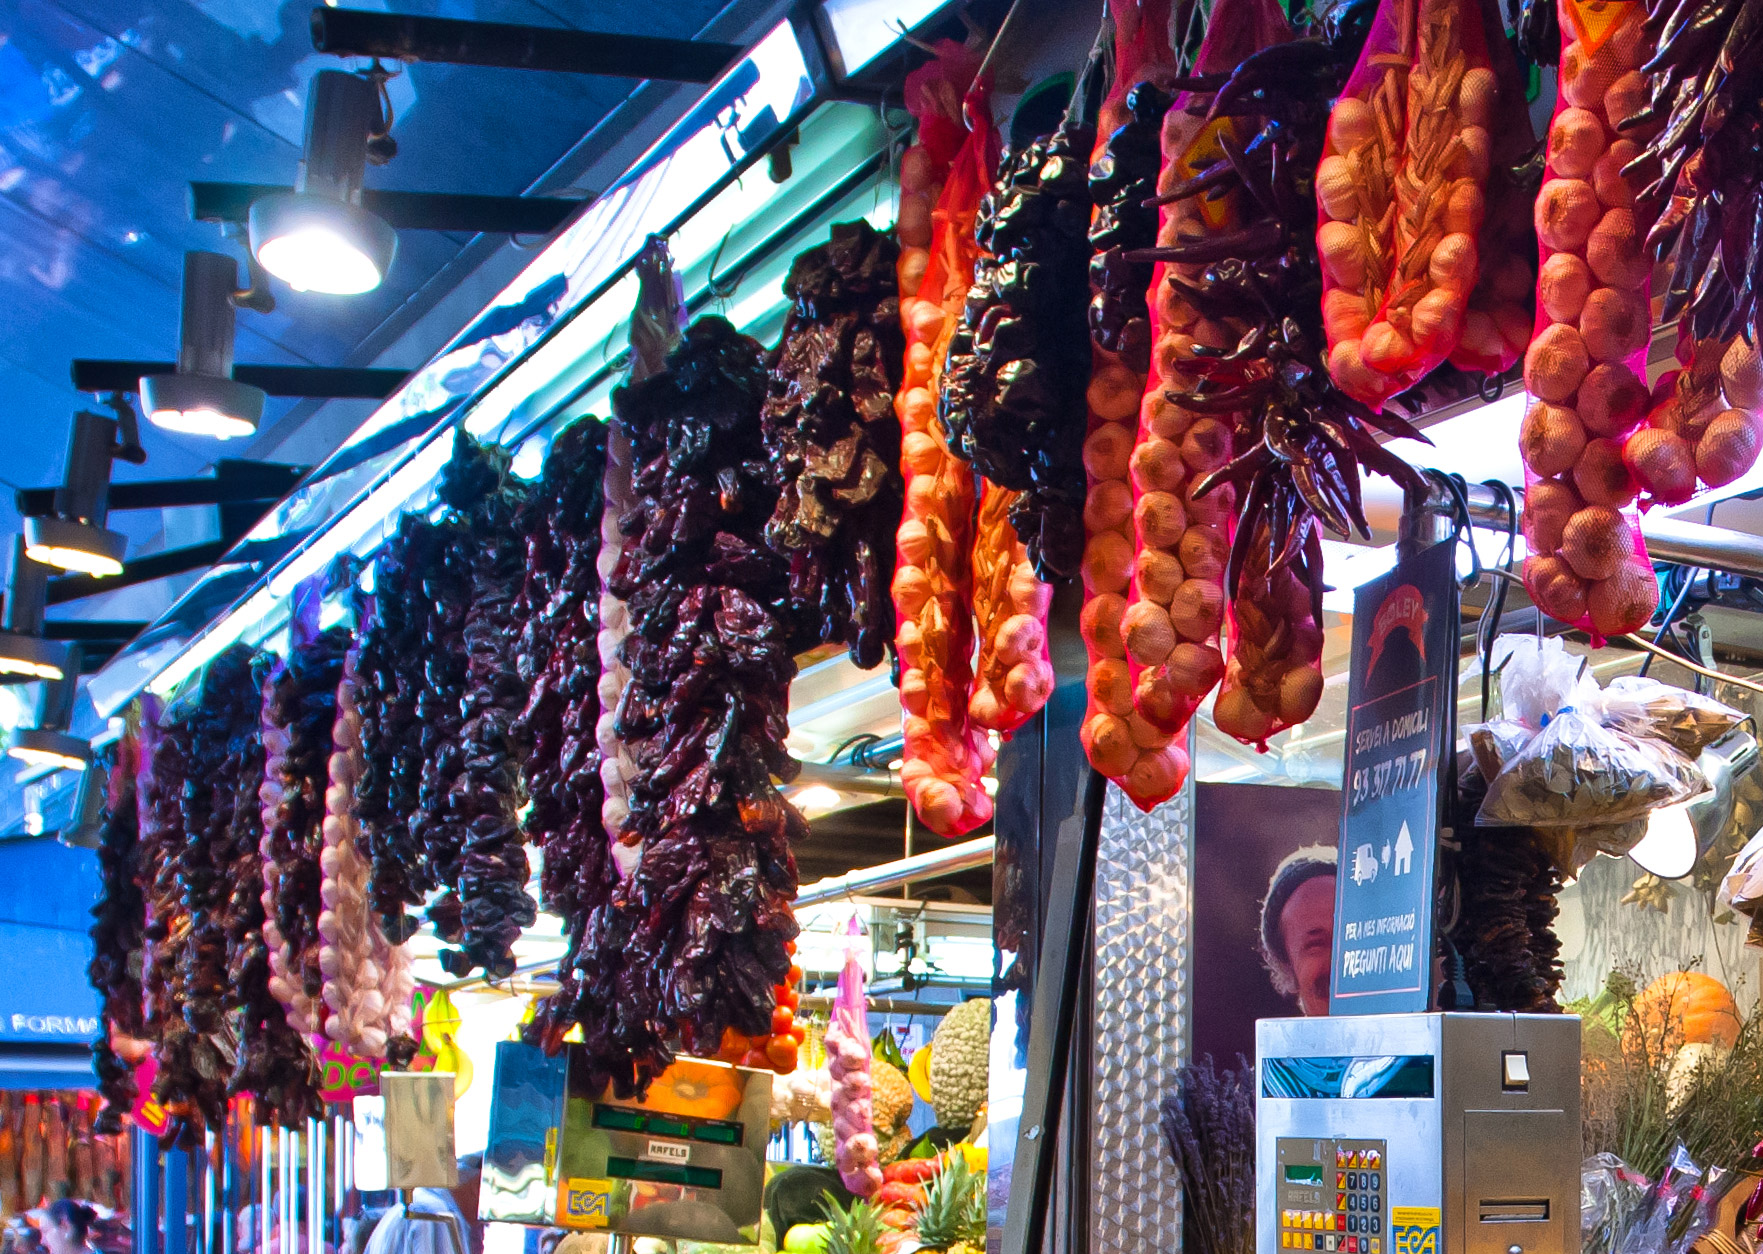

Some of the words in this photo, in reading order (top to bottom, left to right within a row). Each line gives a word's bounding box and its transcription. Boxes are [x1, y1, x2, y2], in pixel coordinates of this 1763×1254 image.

[1355, 724, 1383, 756] SERVEI
[1383, 723, 1390, 747] A
[1391, 707, 1430, 742] DOMICILI
[1353, 766, 1370, 807] 93
[1371, 758, 1392, 799] 317
[1392, 754, 1408, 796] 71
[1408, 748, 1427, 792] 77
[1345, 922, 1357, 941] PER
[1343, 946, 1388, 979] PREGUNTI
